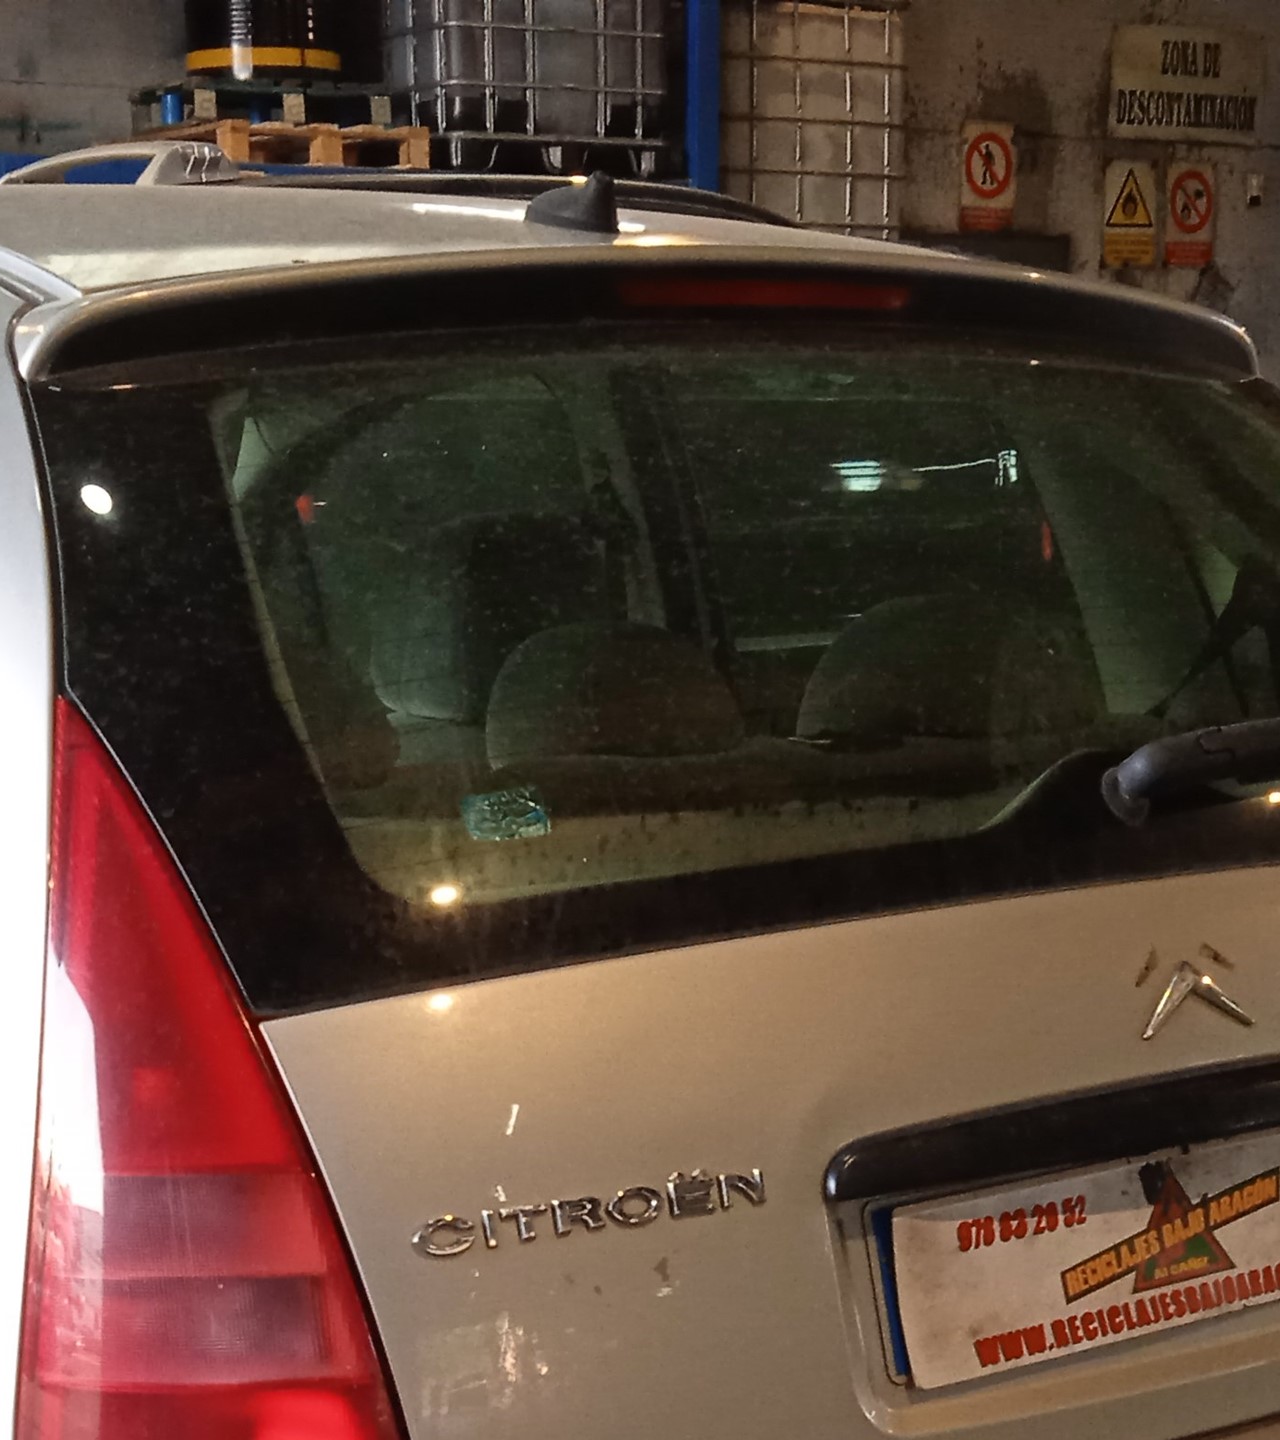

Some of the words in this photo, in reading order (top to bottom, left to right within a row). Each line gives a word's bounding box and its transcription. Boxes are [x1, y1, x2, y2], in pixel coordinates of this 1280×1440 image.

[1161, 40, 1198, 77] ZONA
[1203, 43, 1221, 78] DE
[1116, 86, 1257, 131] DESCONTAMINACIÓN
[411, 1168, 766, 1258] CITROËN
[1062, 1195, 1086, 1228] 52
[1064, 1229, 1161, 1296] RECICLAJES
[1161, 1208, 1205, 1248] BAJO
